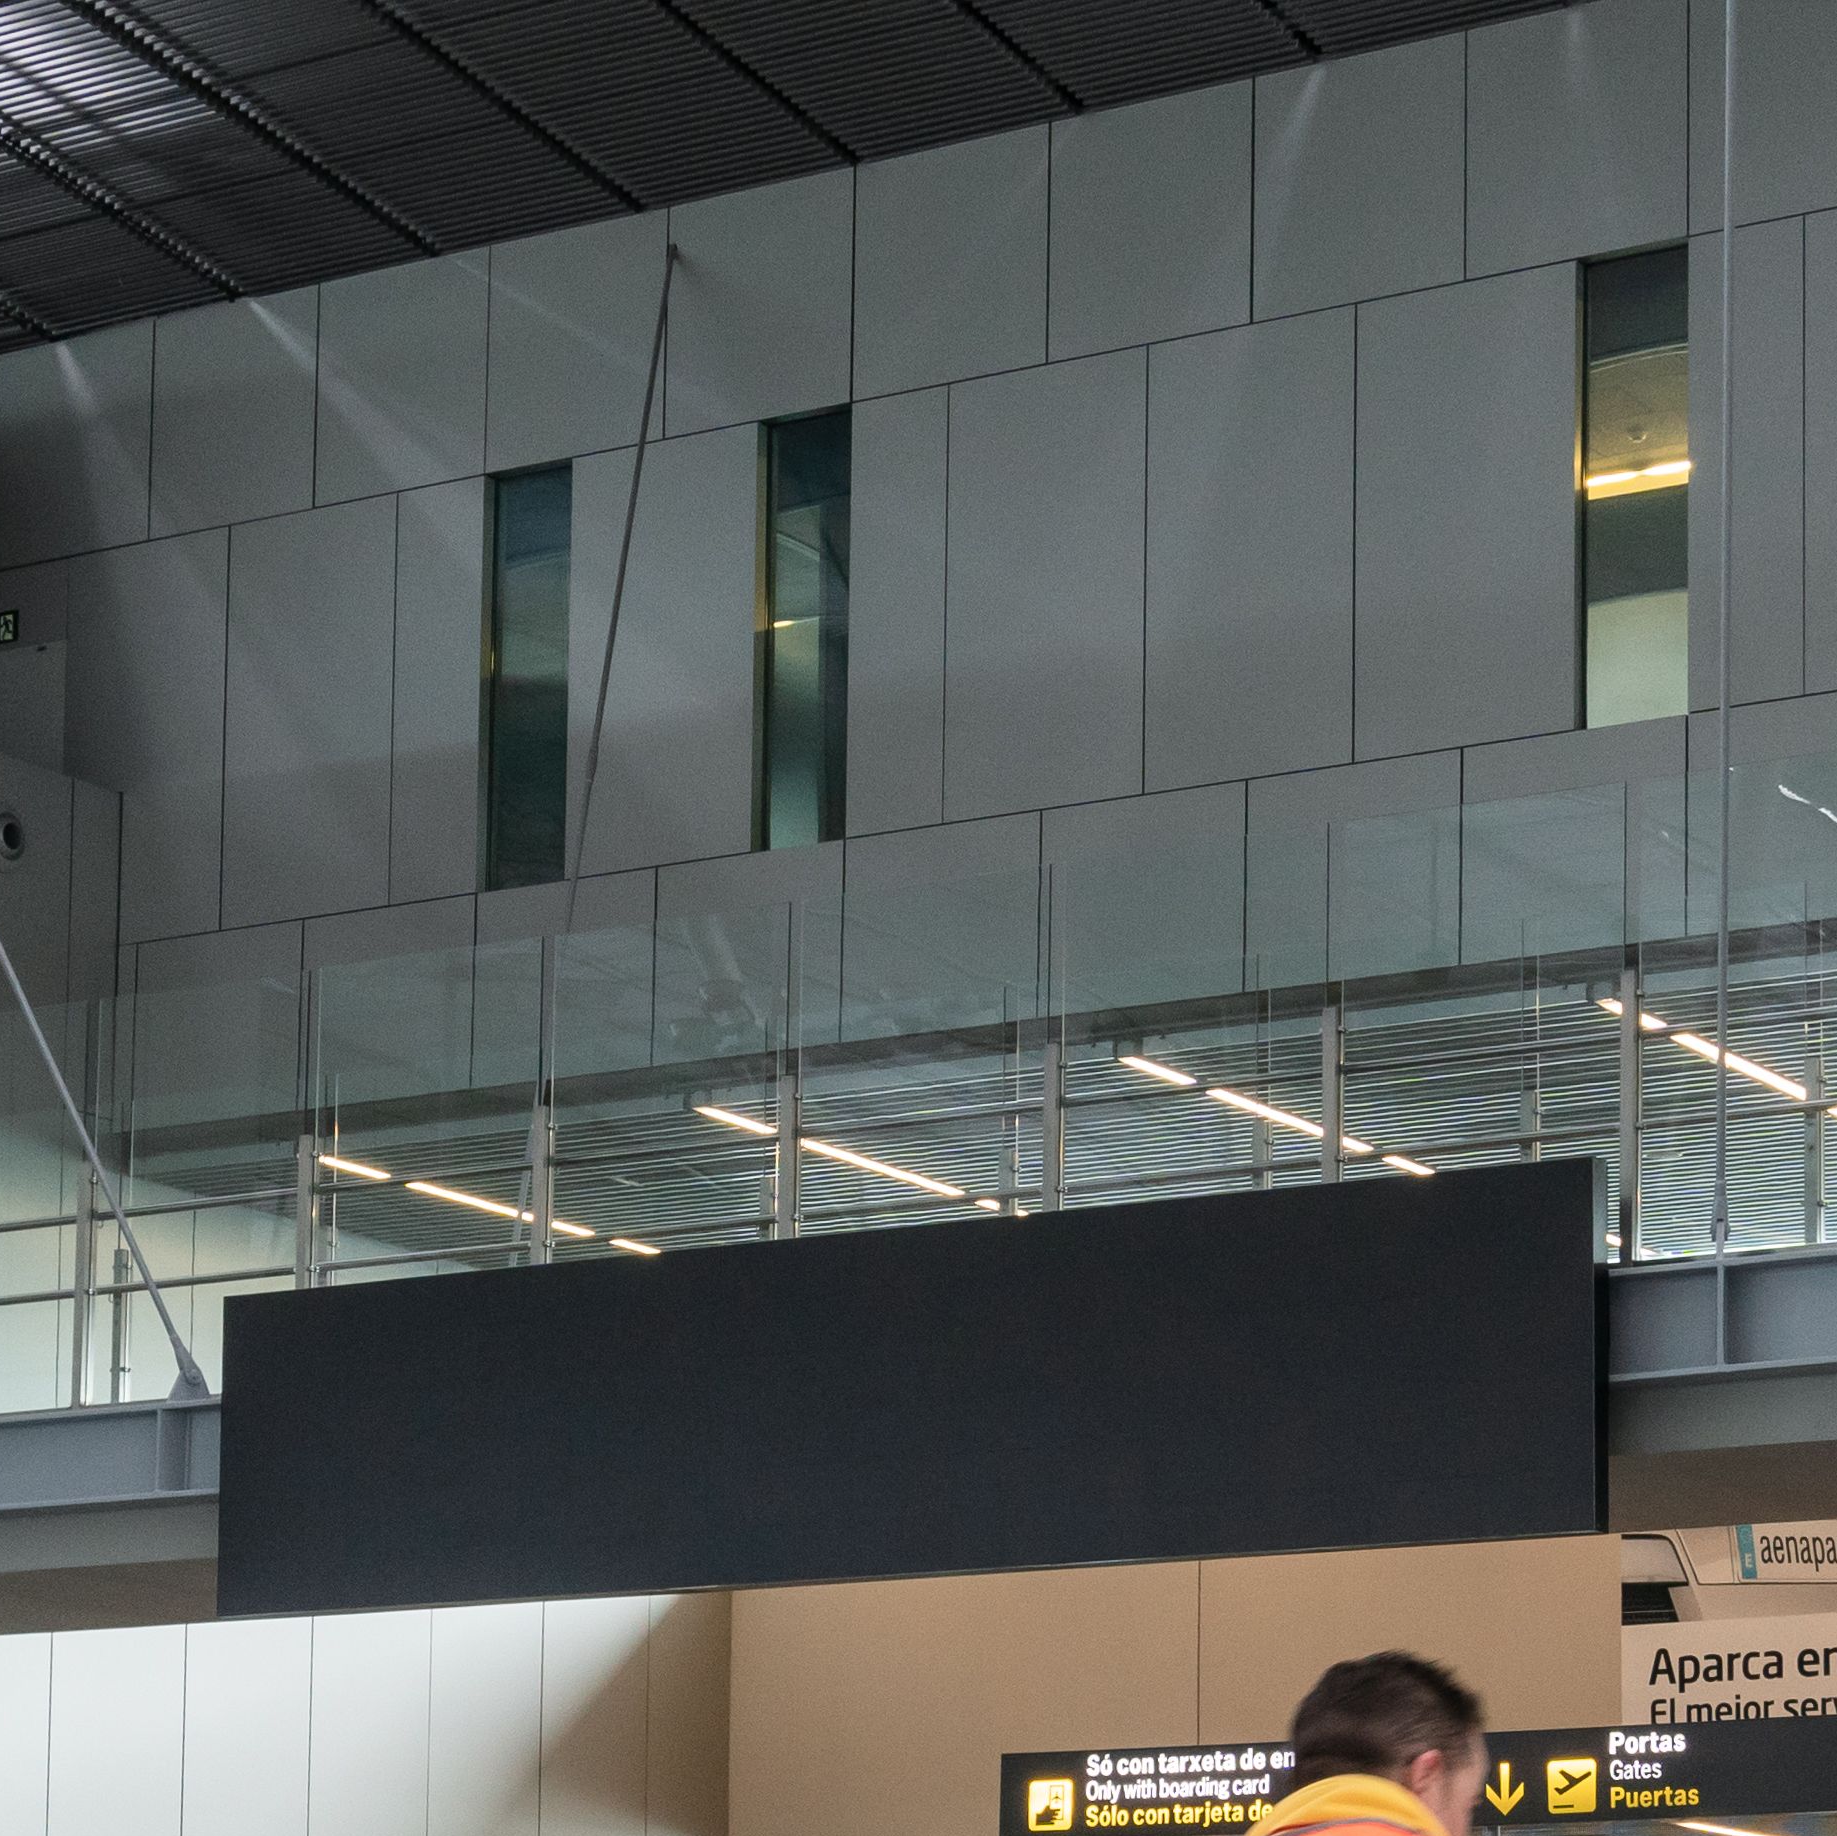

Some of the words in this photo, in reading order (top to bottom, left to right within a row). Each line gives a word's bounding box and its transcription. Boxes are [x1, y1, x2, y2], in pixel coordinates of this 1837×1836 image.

[1649, 1648, 1784, 1693] Aparca
[1650, 1698, 1676, 1724] El
[1608, 1731, 1686, 1755] Portas
[1086, 1754, 1113, 1777] Só
[1117, 1756, 1154, 1775] con
[1158, 1752, 1237, 1773] tarxeta
[1240, 1748, 1266, 1771] de
[1609, 1759, 1662, 1780] Gates
[1086, 1779, 1121, 1804] Only
[1123, 1778, 1156, 1799] with
[1159, 1775, 1229, 1800] boarding
[1232, 1774, 1270, 1795] card
[1610, 1786, 1699, 1809] Puertas
[1085, 1804, 1128, 1827] Sólo
[1133, 1806, 1170, 1825] con
[1173, 1800, 1244, 1828] tarjeta
[1248, 1799, 1274, 1822] de
